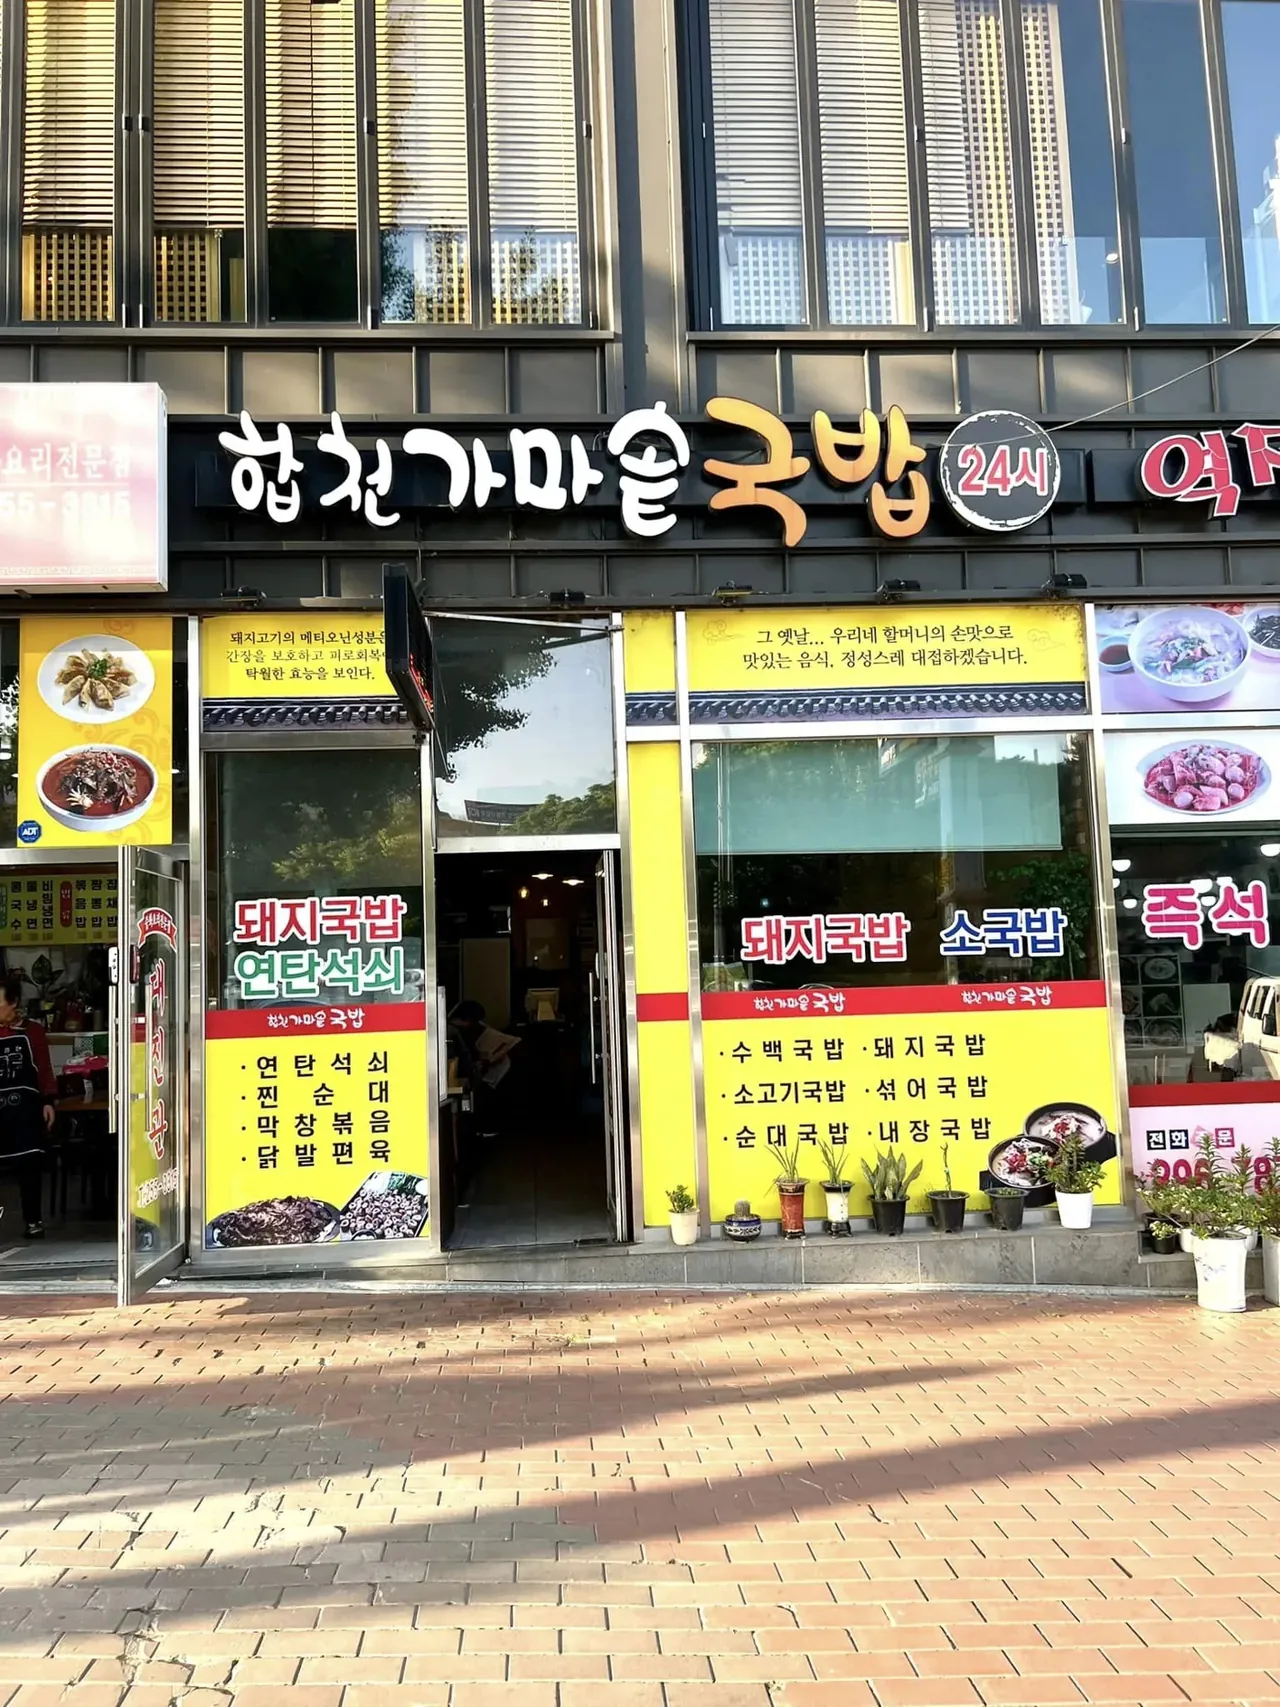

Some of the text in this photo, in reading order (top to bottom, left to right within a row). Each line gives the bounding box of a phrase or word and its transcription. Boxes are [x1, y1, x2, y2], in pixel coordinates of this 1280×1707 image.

[0, 442, 131, 482] 요리전문점
[958, 445, 1048, 497] 24시
[230, 631, 294, 645] 돼지고기의
[757, 631, 774, 645] 그
[830, 626, 878, 645] 우리네
[884, 624, 946, 644] 할머니의
[950, 624, 1014, 641] 손맛으로
[226, 648, 386, 663] 간장을 보호하고 피로회복
[742, 649, 793, 669] 맛있는
[840, 647, 905, 668] 정성스레
[911, 646, 1028, 667] 대접하겠습니다.
[246, 666, 375, 681] 탁월한 효능을 보인다.
[21, 827, 39, 836] ADT
[234, 895, 407, 946] 돼지국밥
[1141, 881, 1271, 949] 즉석
[741, 911, 909, 965] 돼지국밥
[940, 906, 1067, 958] 소국밥
[234, 946, 404, 999] 연탄석쇠
[733, 1079, 847, 1105] 소고기국밥
